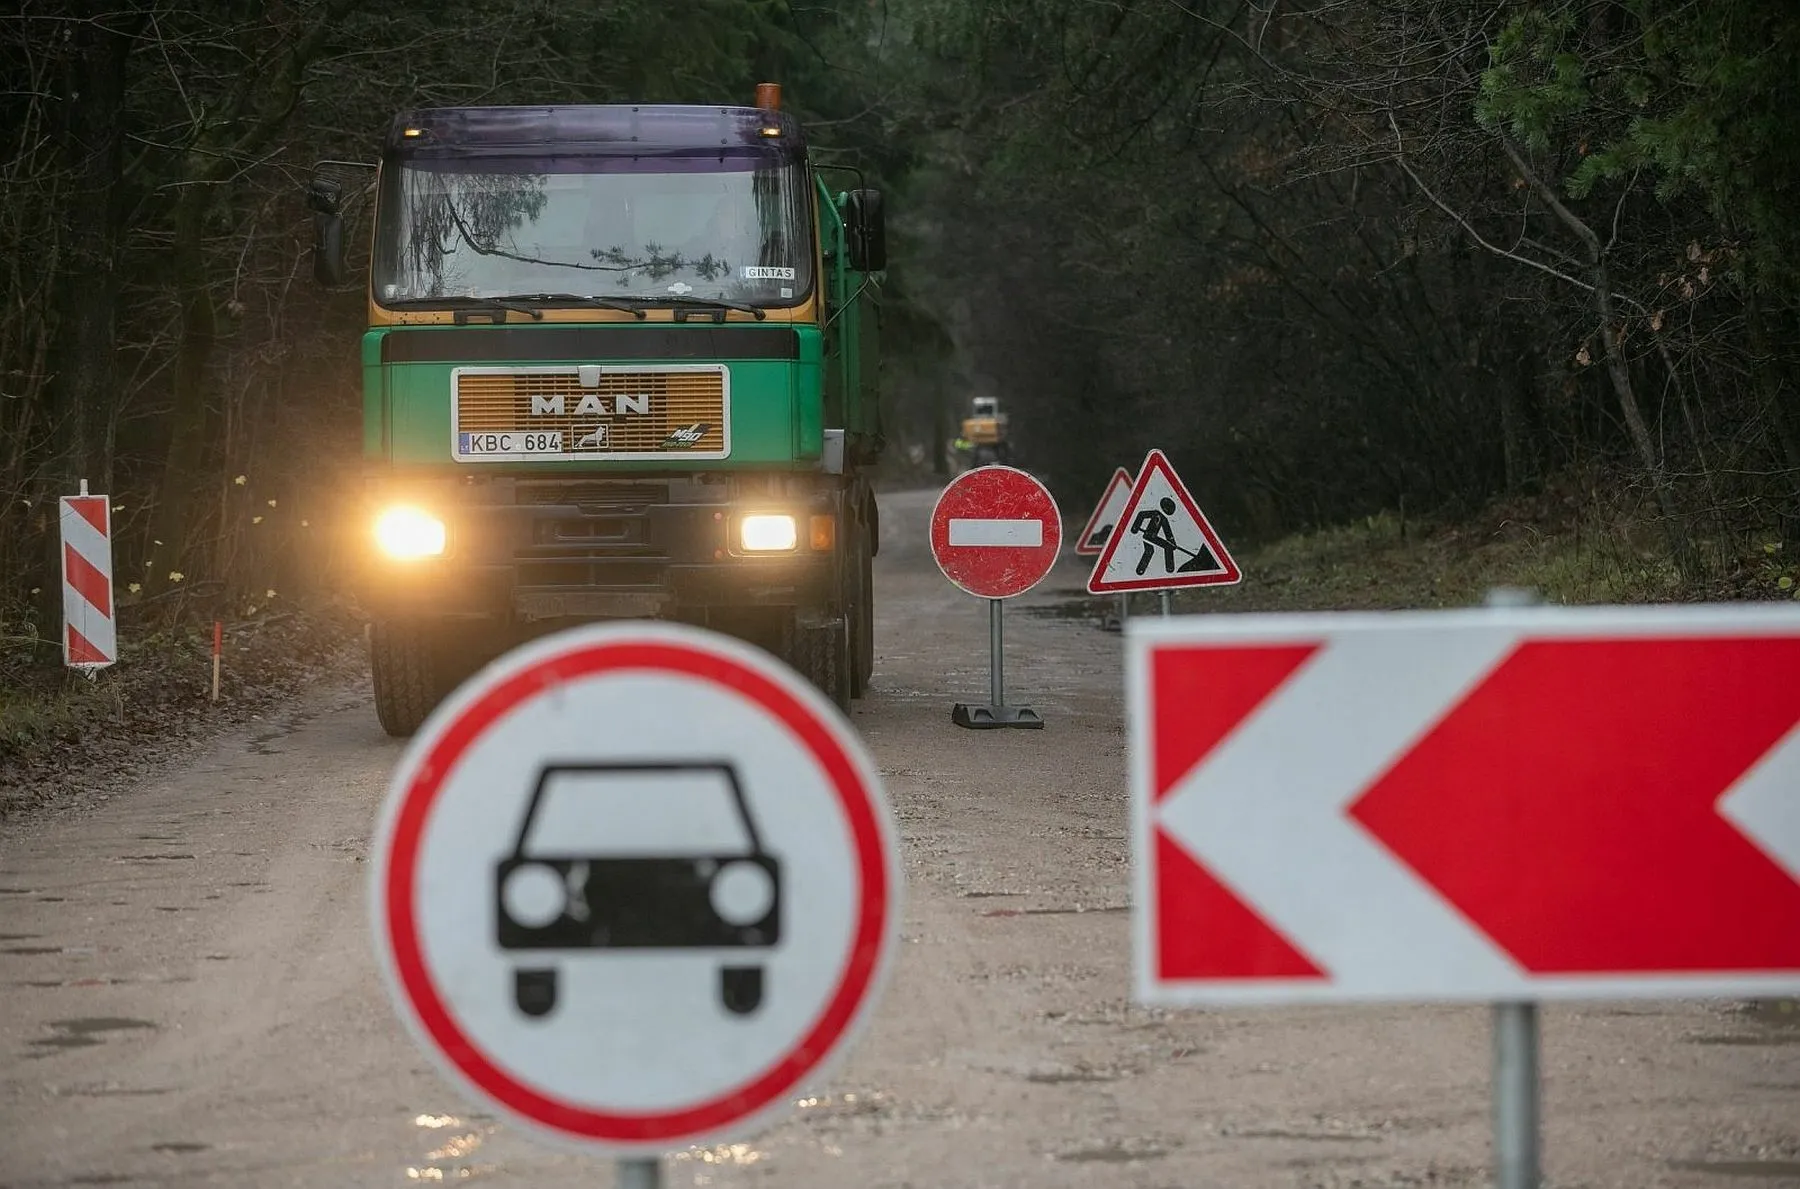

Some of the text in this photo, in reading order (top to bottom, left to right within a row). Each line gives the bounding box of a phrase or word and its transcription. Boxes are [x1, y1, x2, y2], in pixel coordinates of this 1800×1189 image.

[748, 268, 792, 278] GINTAS
[531, 394, 649, 415] MAN
[471, 434, 560, 451] KBC 684
